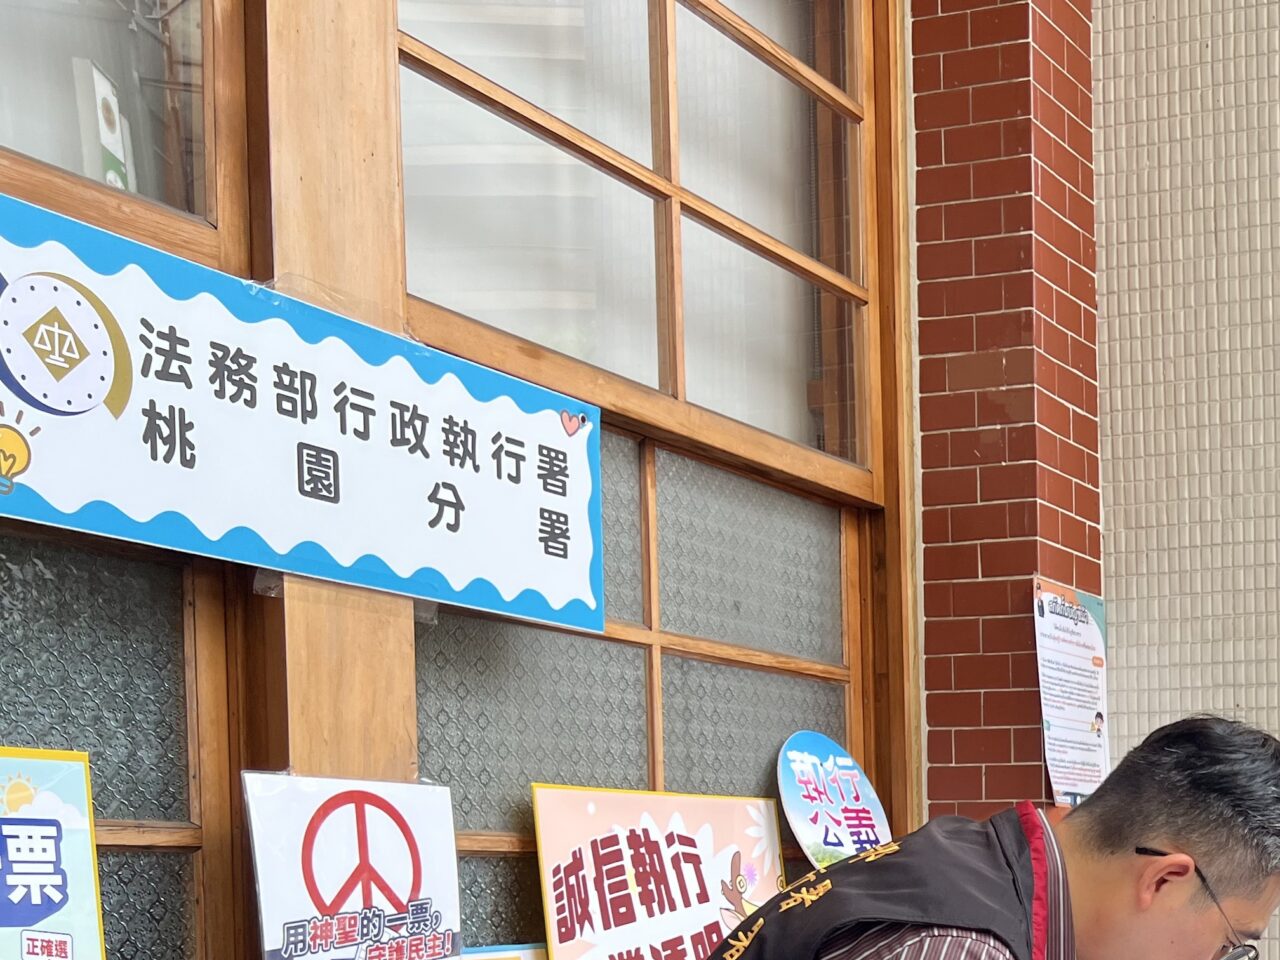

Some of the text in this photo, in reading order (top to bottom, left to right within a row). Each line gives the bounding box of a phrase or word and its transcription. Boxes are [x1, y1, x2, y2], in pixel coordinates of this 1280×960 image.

[139, 317, 570, 498] 法務部行政執行署
[142, 400, 571, 560] 桃園分署
[786, 750, 861, 805] 執行
[6, 823, 64, 906] 票
[553, 828, 711, 944] 誠信執行
[25, 937, 69, 960] 正確選
